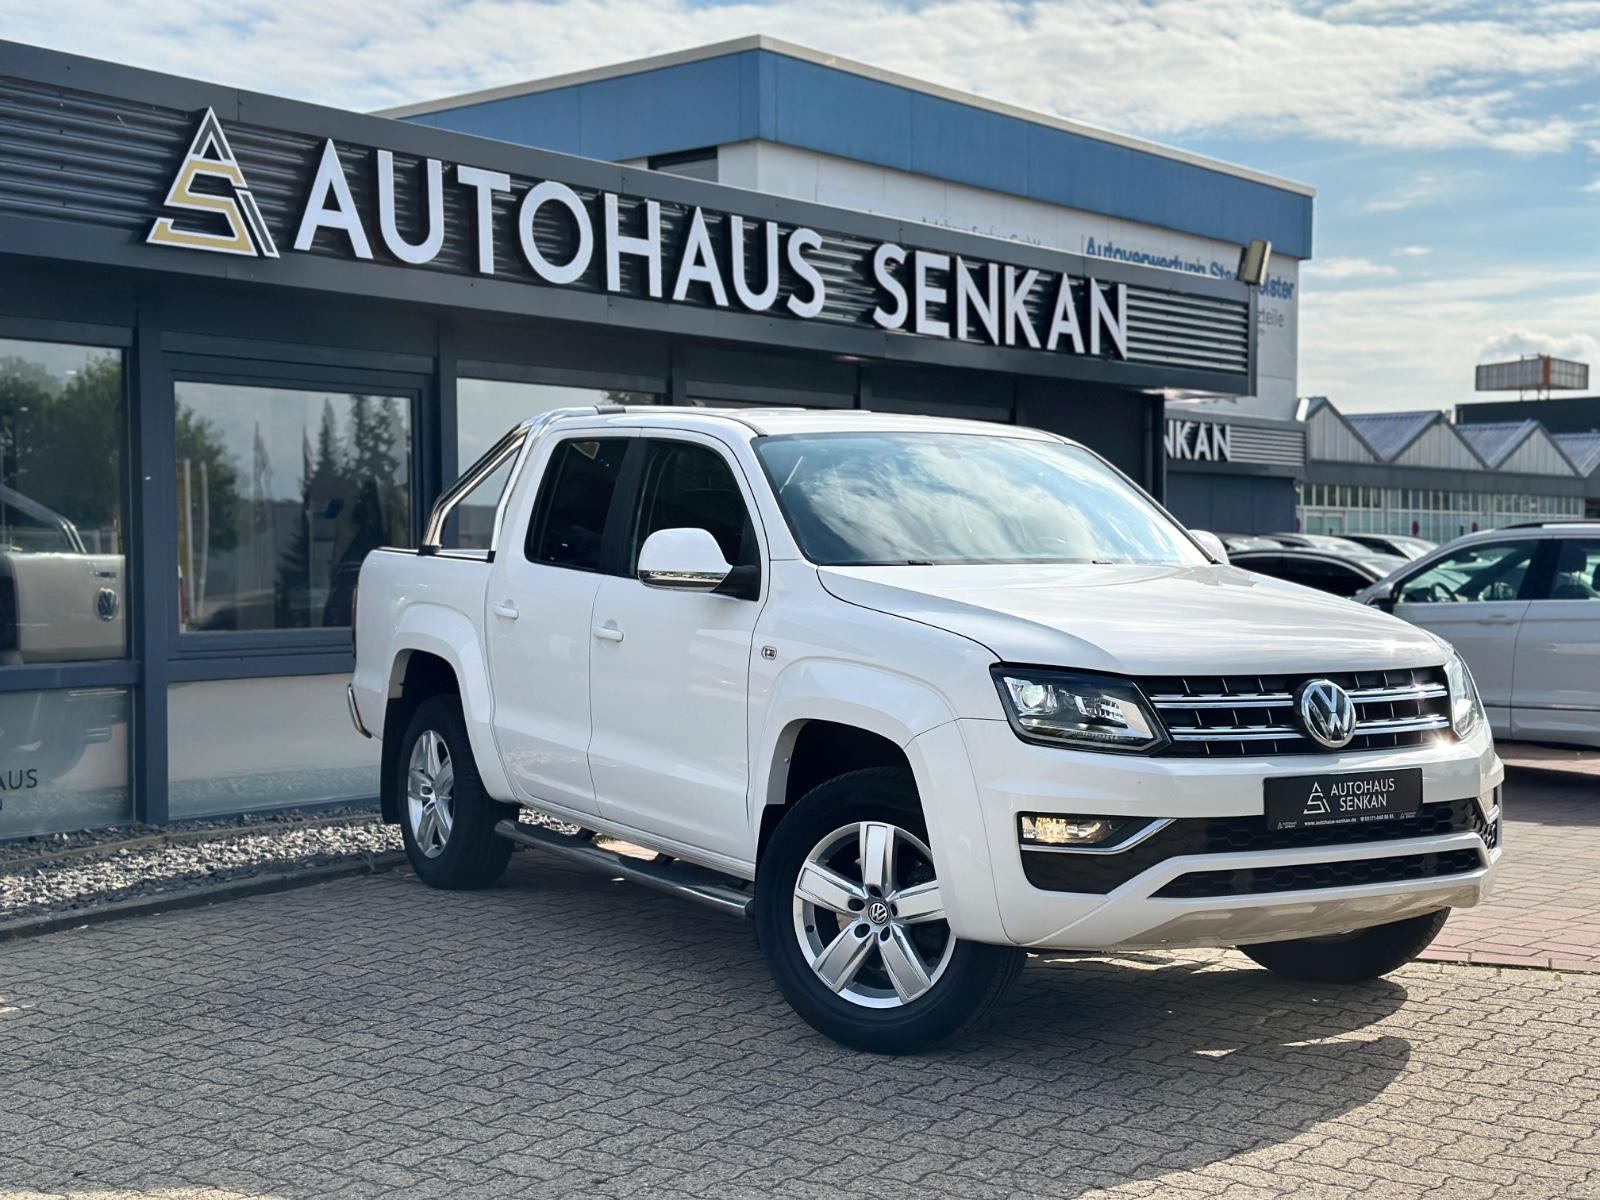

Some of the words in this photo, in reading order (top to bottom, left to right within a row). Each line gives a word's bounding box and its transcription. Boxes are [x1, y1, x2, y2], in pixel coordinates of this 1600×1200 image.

[293, 138, 826, 319] AUTOHAUS
[873, 243, 1128, 361] SENKAN
[1330, 778, 1396, 797] AUTOHAUS
[1339, 793, 1387, 811] SENKAN
